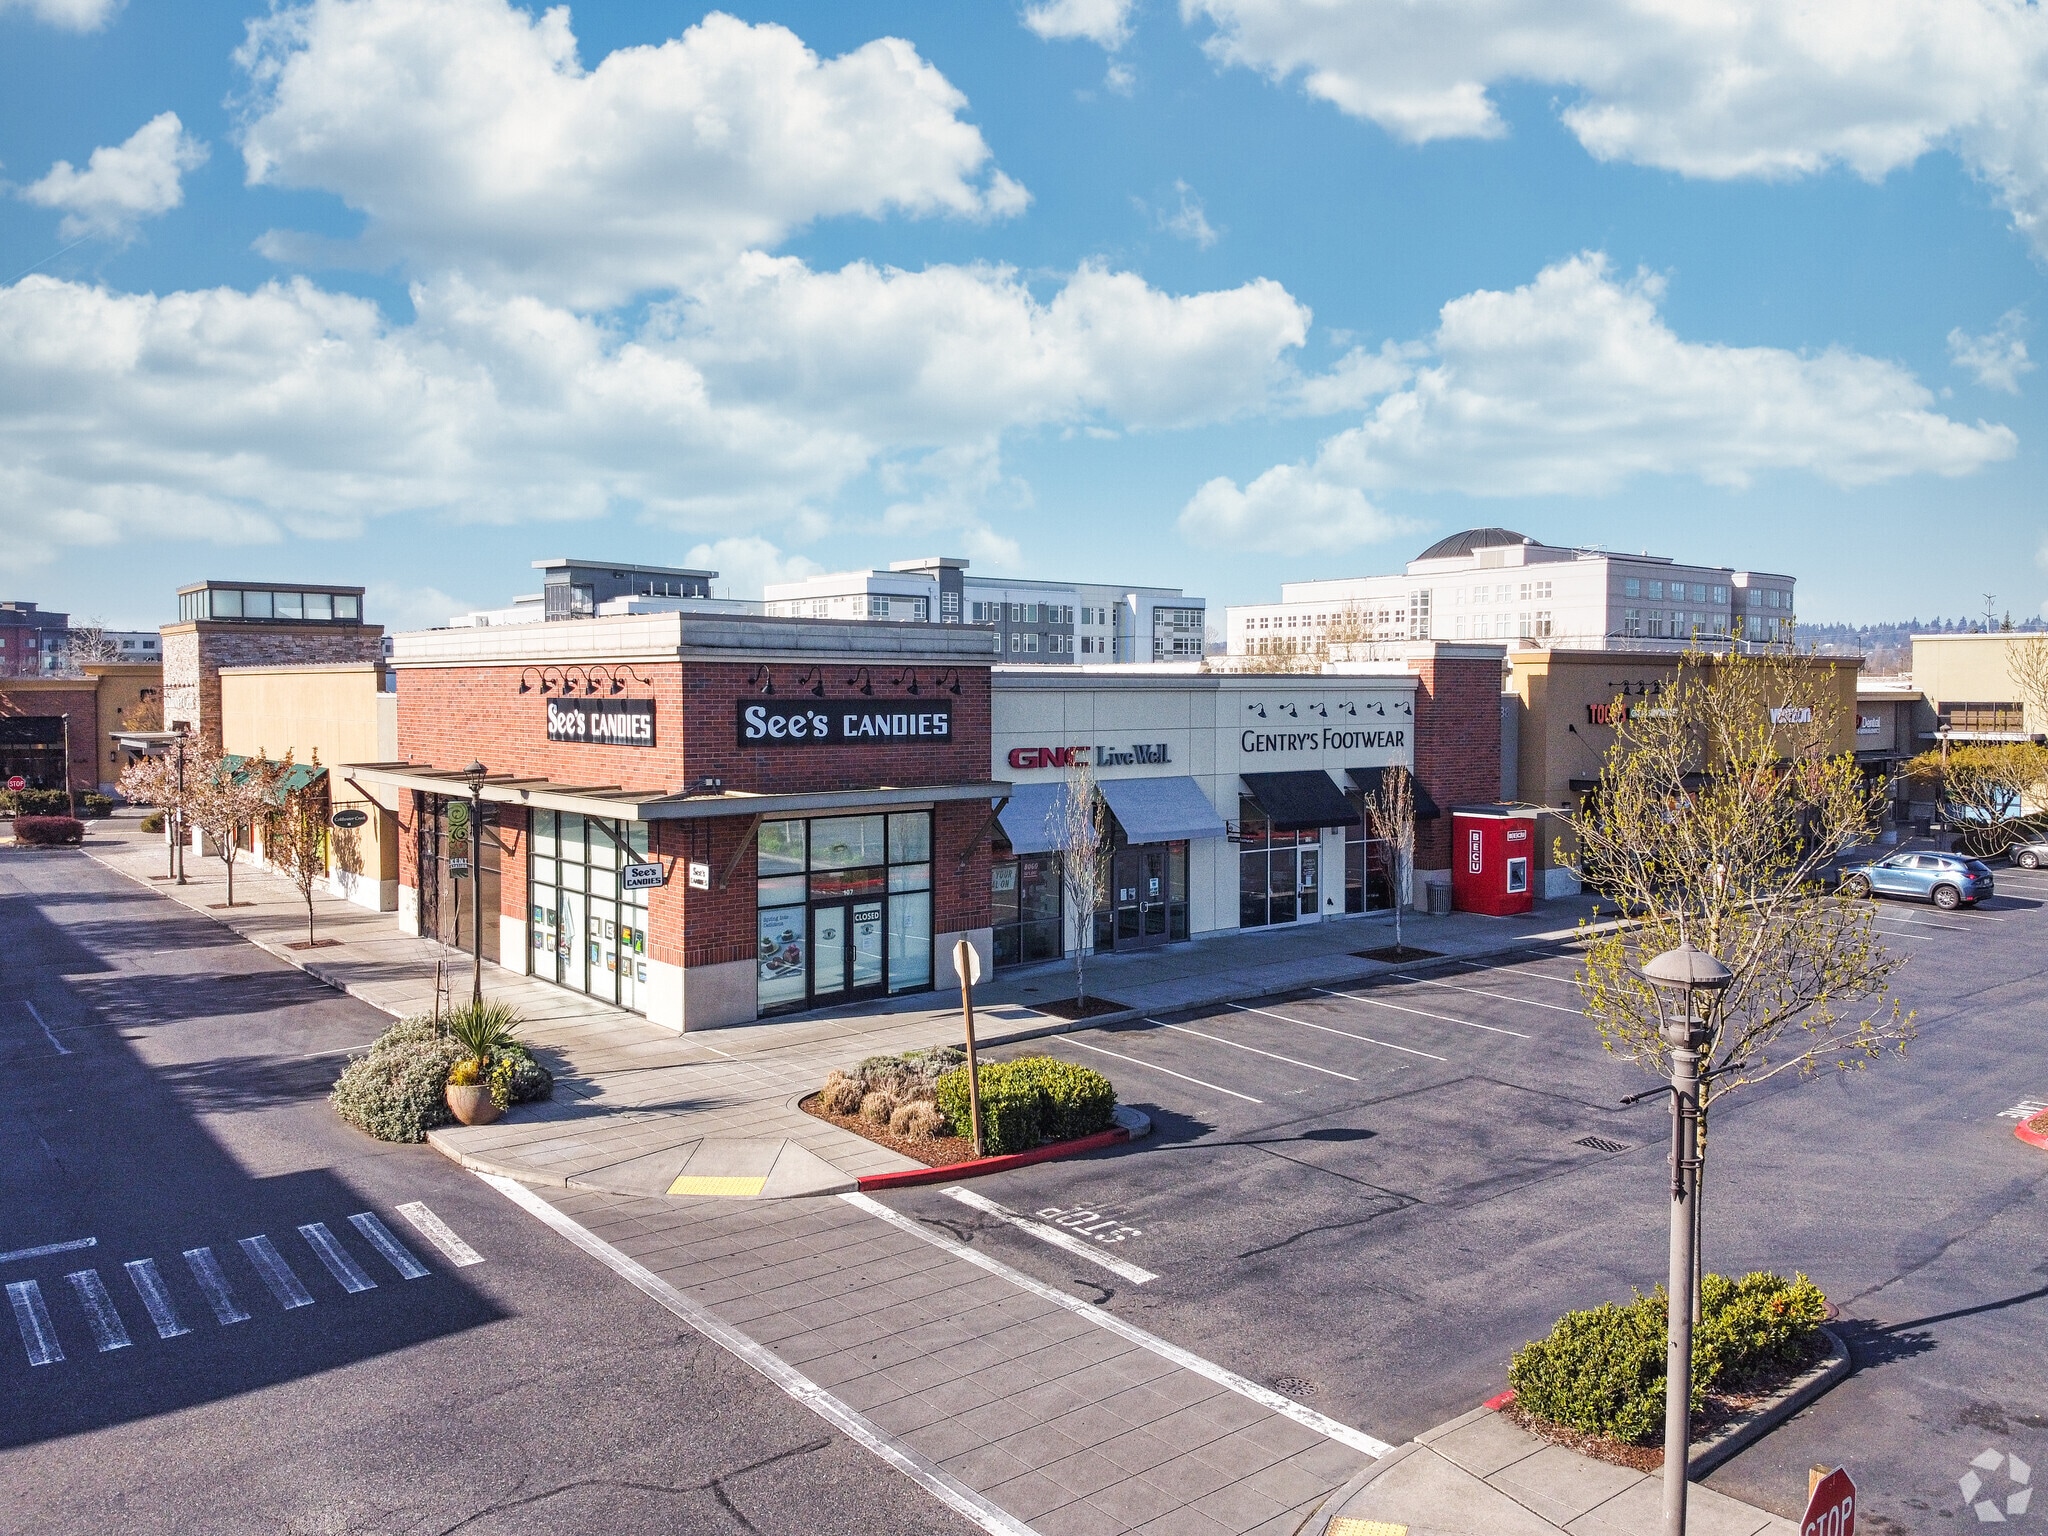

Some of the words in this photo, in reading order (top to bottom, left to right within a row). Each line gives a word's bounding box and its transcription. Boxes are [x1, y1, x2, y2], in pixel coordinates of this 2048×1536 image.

[547, 703, 586, 735] See's
[591, 713, 651, 738] CANDIES
[745, 705, 829, 738] See's
[843, 713, 948, 737] CANDIES
[1588, 703, 1627, 724] TOGS
[1241, 730, 1319, 752] GENTRY'S
[1323, 728, 1405, 749] FOOTWEAR
[1008, 746, 1091, 768] GNC
[1508, 831, 1525, 839] BECU
[1472, 832, 1480, 871] BECU
[626, 877, 661, 887] CANDIES
[631, 867, 657, 877] See's
[995, 869, 1013, 879] YOUR
[854, 911, 880, 921] CLOSED
[1035, 1206, 1143, 1243] STOP
